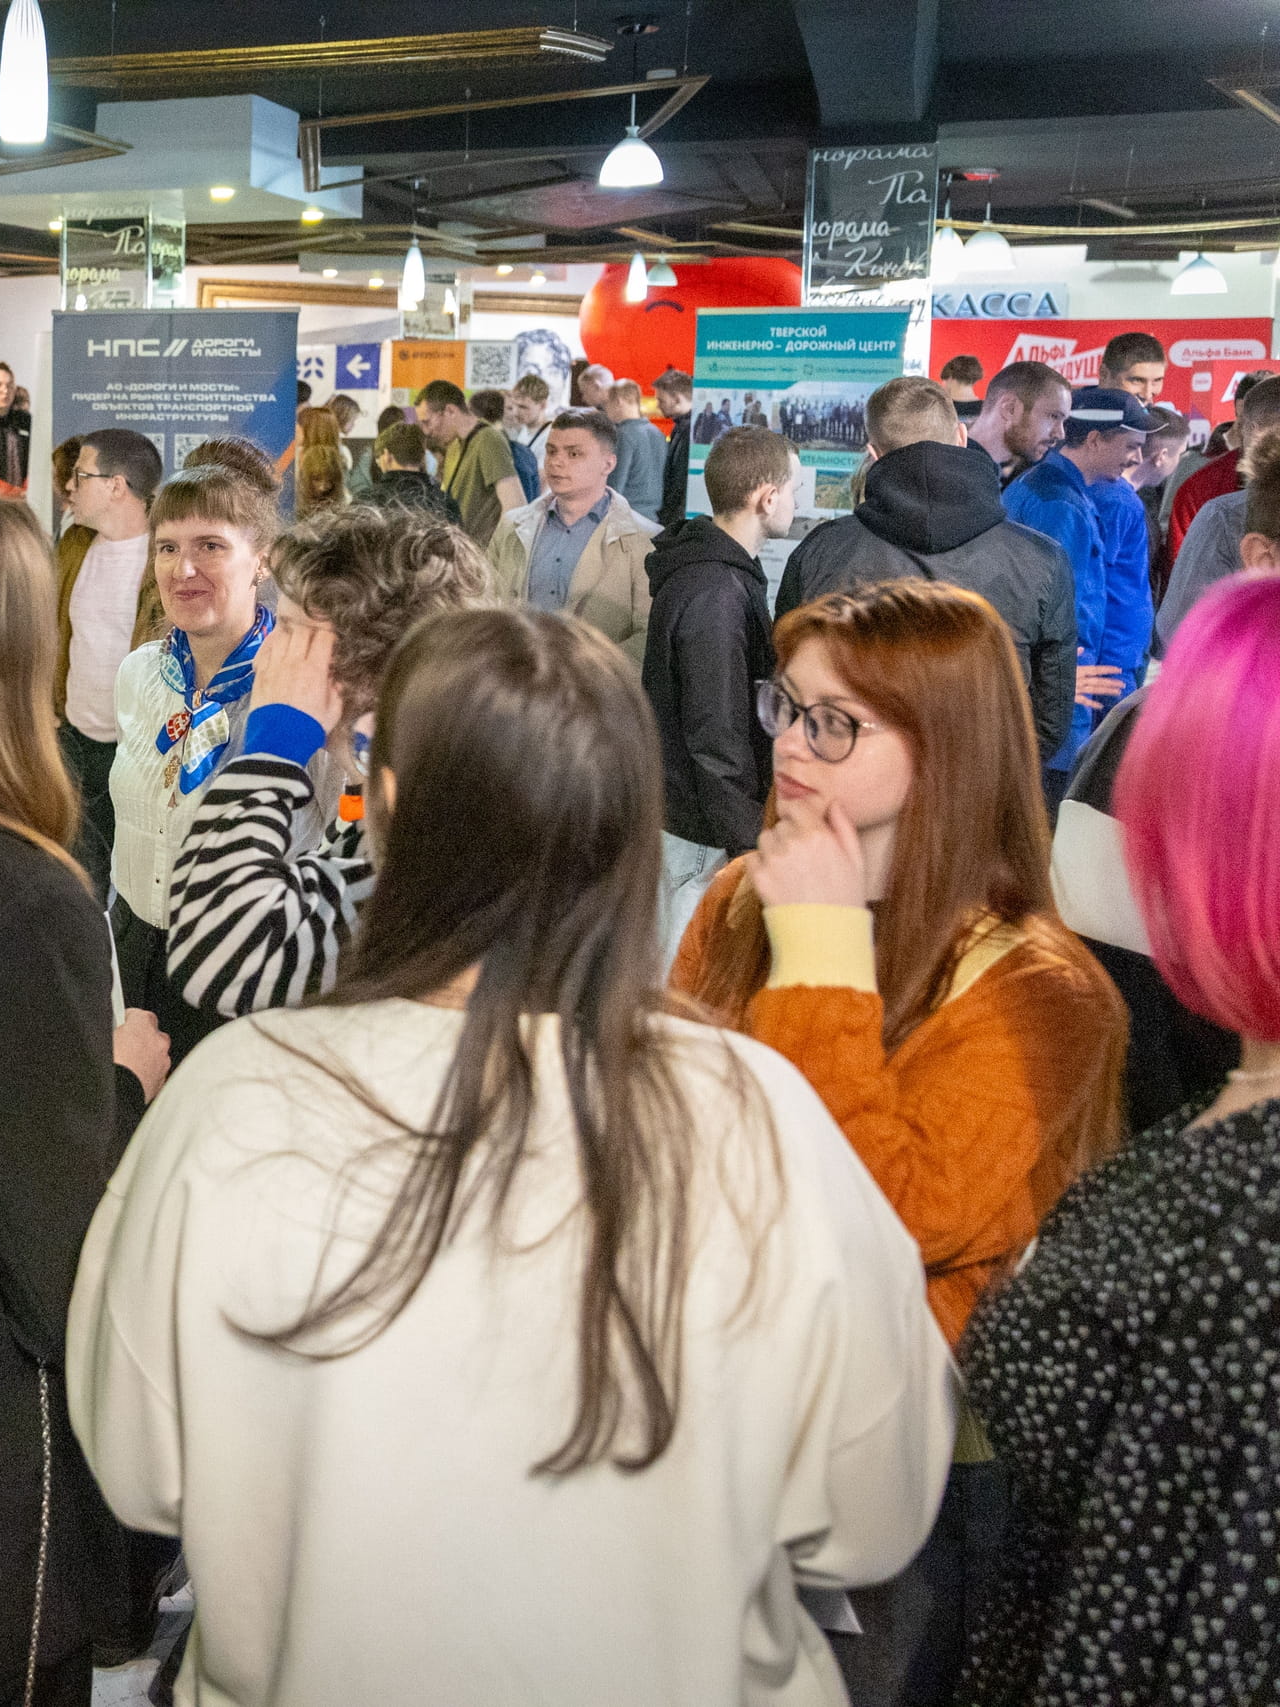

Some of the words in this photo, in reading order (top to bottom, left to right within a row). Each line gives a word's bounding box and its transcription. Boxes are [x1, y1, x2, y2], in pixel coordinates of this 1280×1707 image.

[868, 170, 930, 206] Па
[931, 292, 1060, 317] КАССА
[770, 324, 827, 338] ТВЕРСКОЙ
[87, 338, 161, 358] НПС
[191, 338, 255, 348] ДОРОГИ
[706, 340, 774, 351] ИНЖЕНЕРНО
[785, 338, 856, 353] ДОРОЖНЫЙ
[859, 341, 896, 353] ЦЕНТР
[191, 348, 203, 358] И
[205, 348, 262, 358] МОСТЫ
